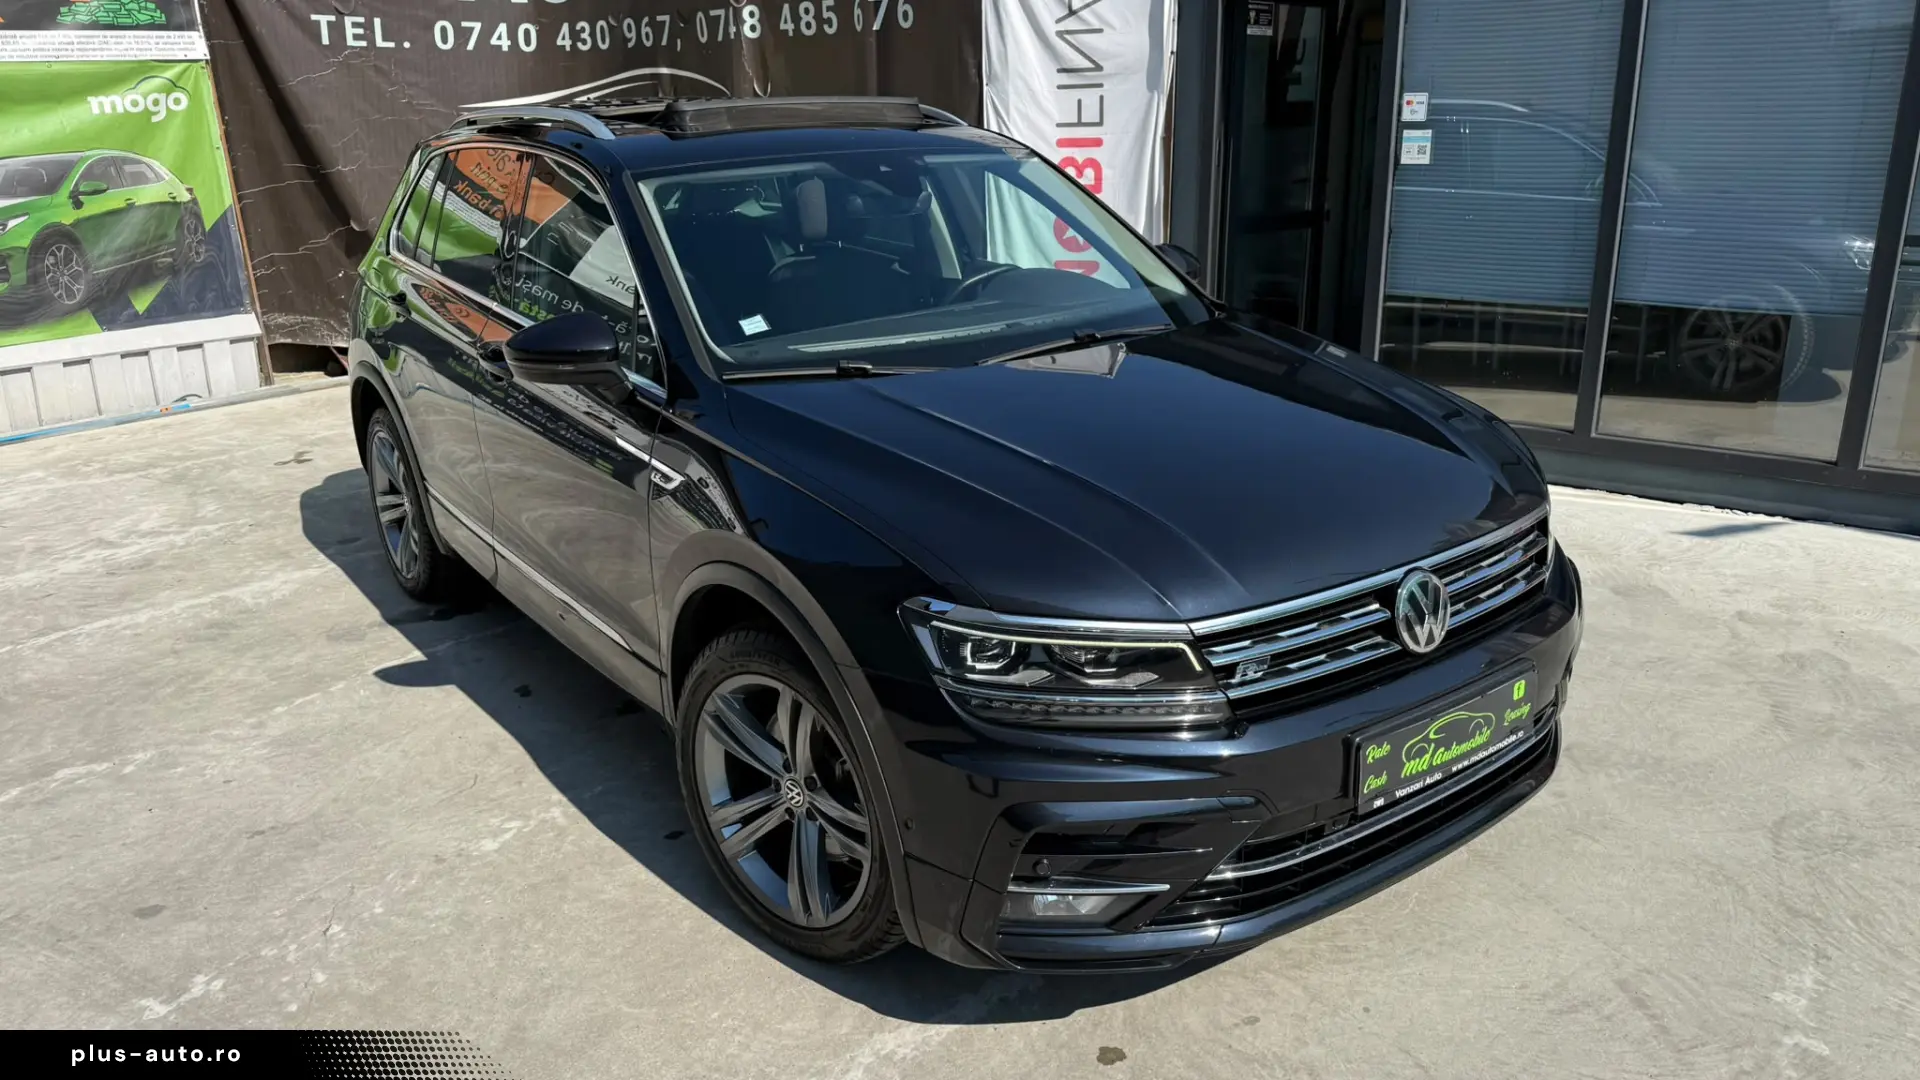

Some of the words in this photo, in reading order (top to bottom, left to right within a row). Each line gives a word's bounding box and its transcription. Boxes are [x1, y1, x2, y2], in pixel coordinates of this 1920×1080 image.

[310, 14, 411, 48] TEL.
[433, 20, 538, 52] 0740
[556, 20, 610, 51] 430
[780, 0, 837, 37] 485
[87, 91, 189, 122] mogo
[1401, 743, 1435, 779] md
[1363, 771, 1388, 794] Cash
[1395, 779, 1424, 798] Vanzari
[1424, 772, 1442, 787] Auto
